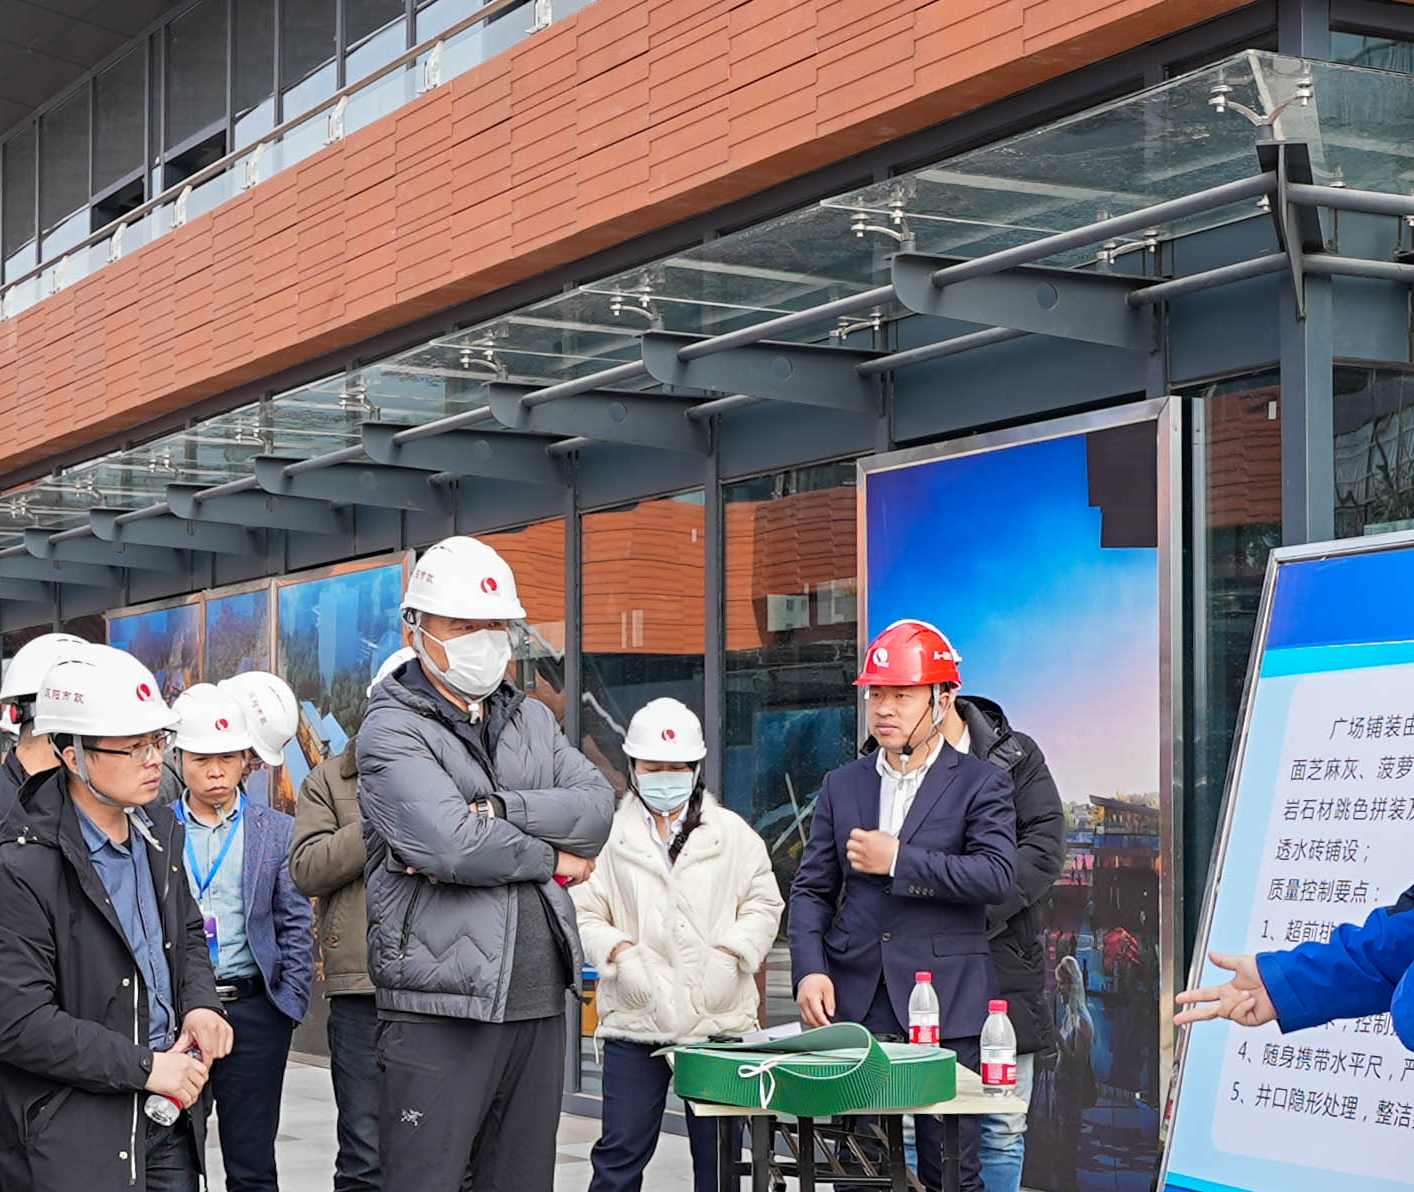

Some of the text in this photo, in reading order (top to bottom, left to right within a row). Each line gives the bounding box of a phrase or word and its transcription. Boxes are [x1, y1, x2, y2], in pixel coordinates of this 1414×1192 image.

[43, 686, 85, 705] 汉阳市政
[1267, 877, 1380, 905] 质量控制要点：
